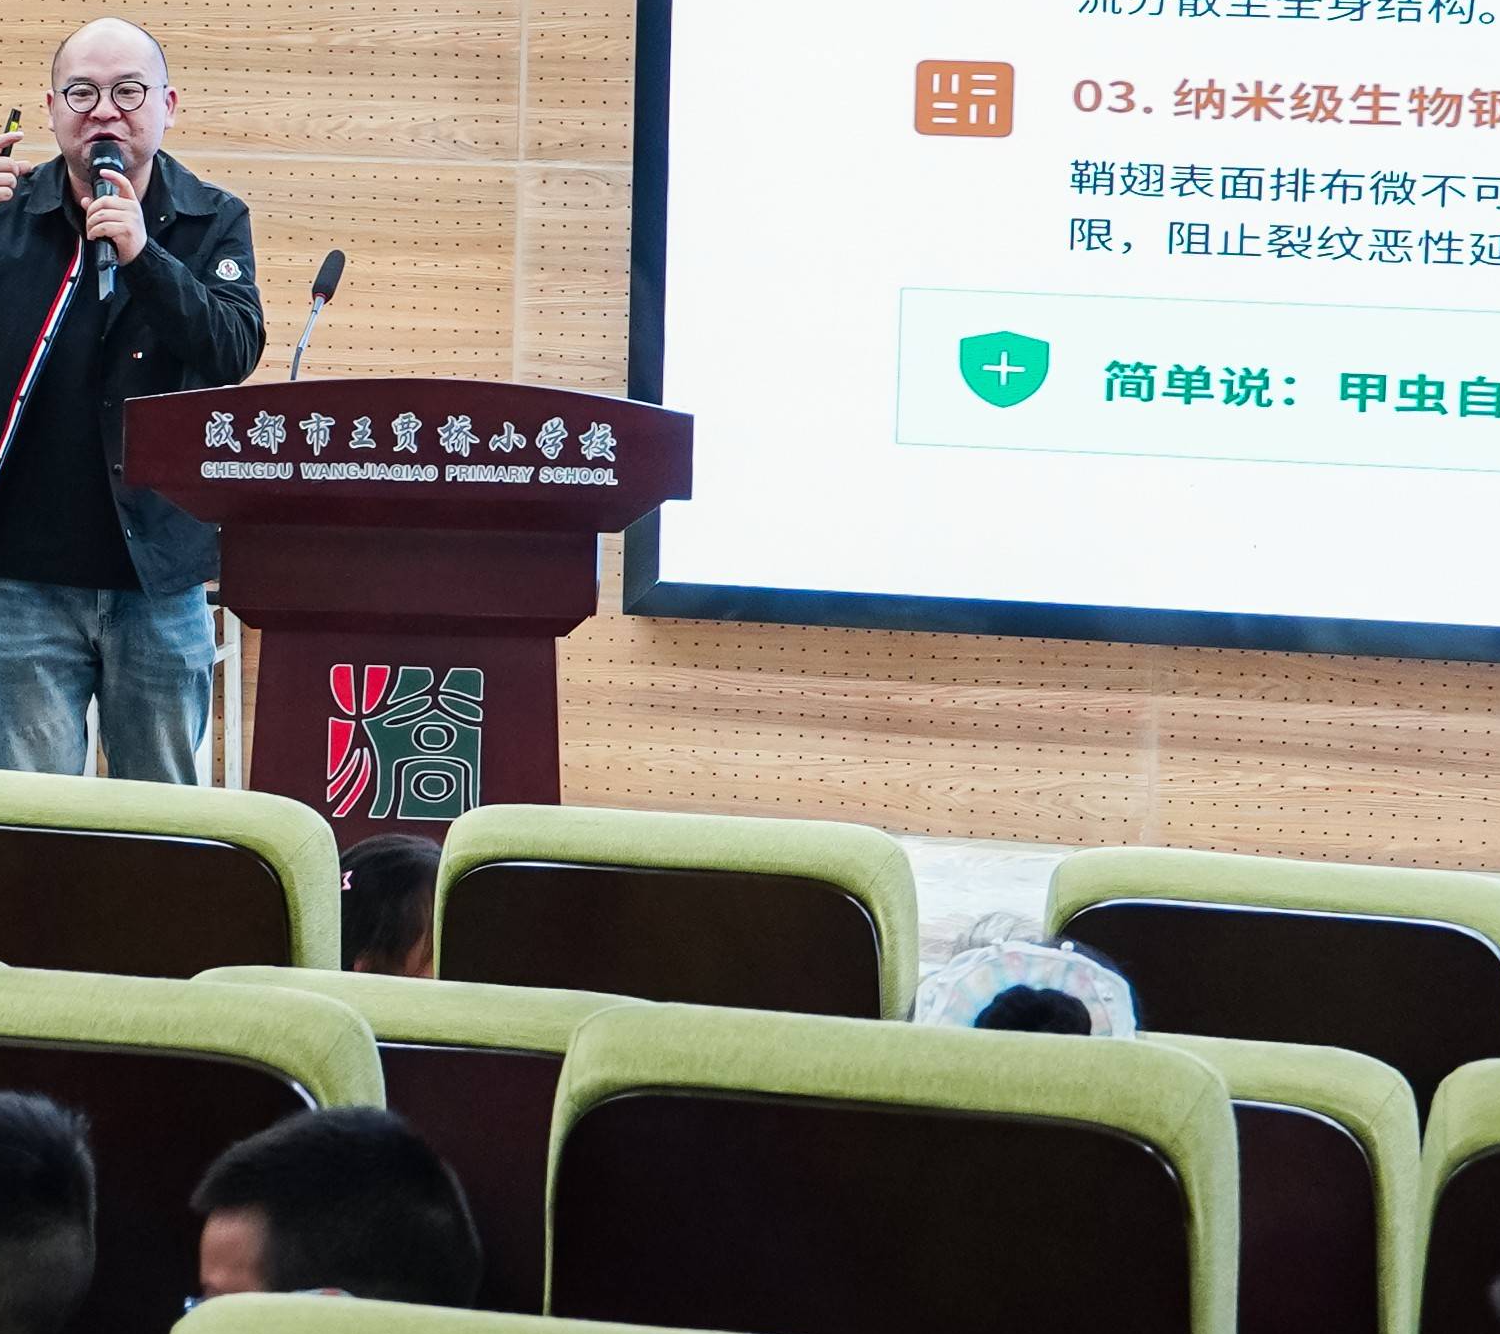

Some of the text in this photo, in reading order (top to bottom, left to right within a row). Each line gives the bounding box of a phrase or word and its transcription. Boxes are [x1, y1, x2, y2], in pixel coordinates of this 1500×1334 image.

[1074, 80, 1152, 114] 03.
[205, 411, 617, 461] 成都市王贾桥小学校
[200, 461, 618, 486] CHENGDU WANGJIAQIAO PRIMARY SCHOOL
